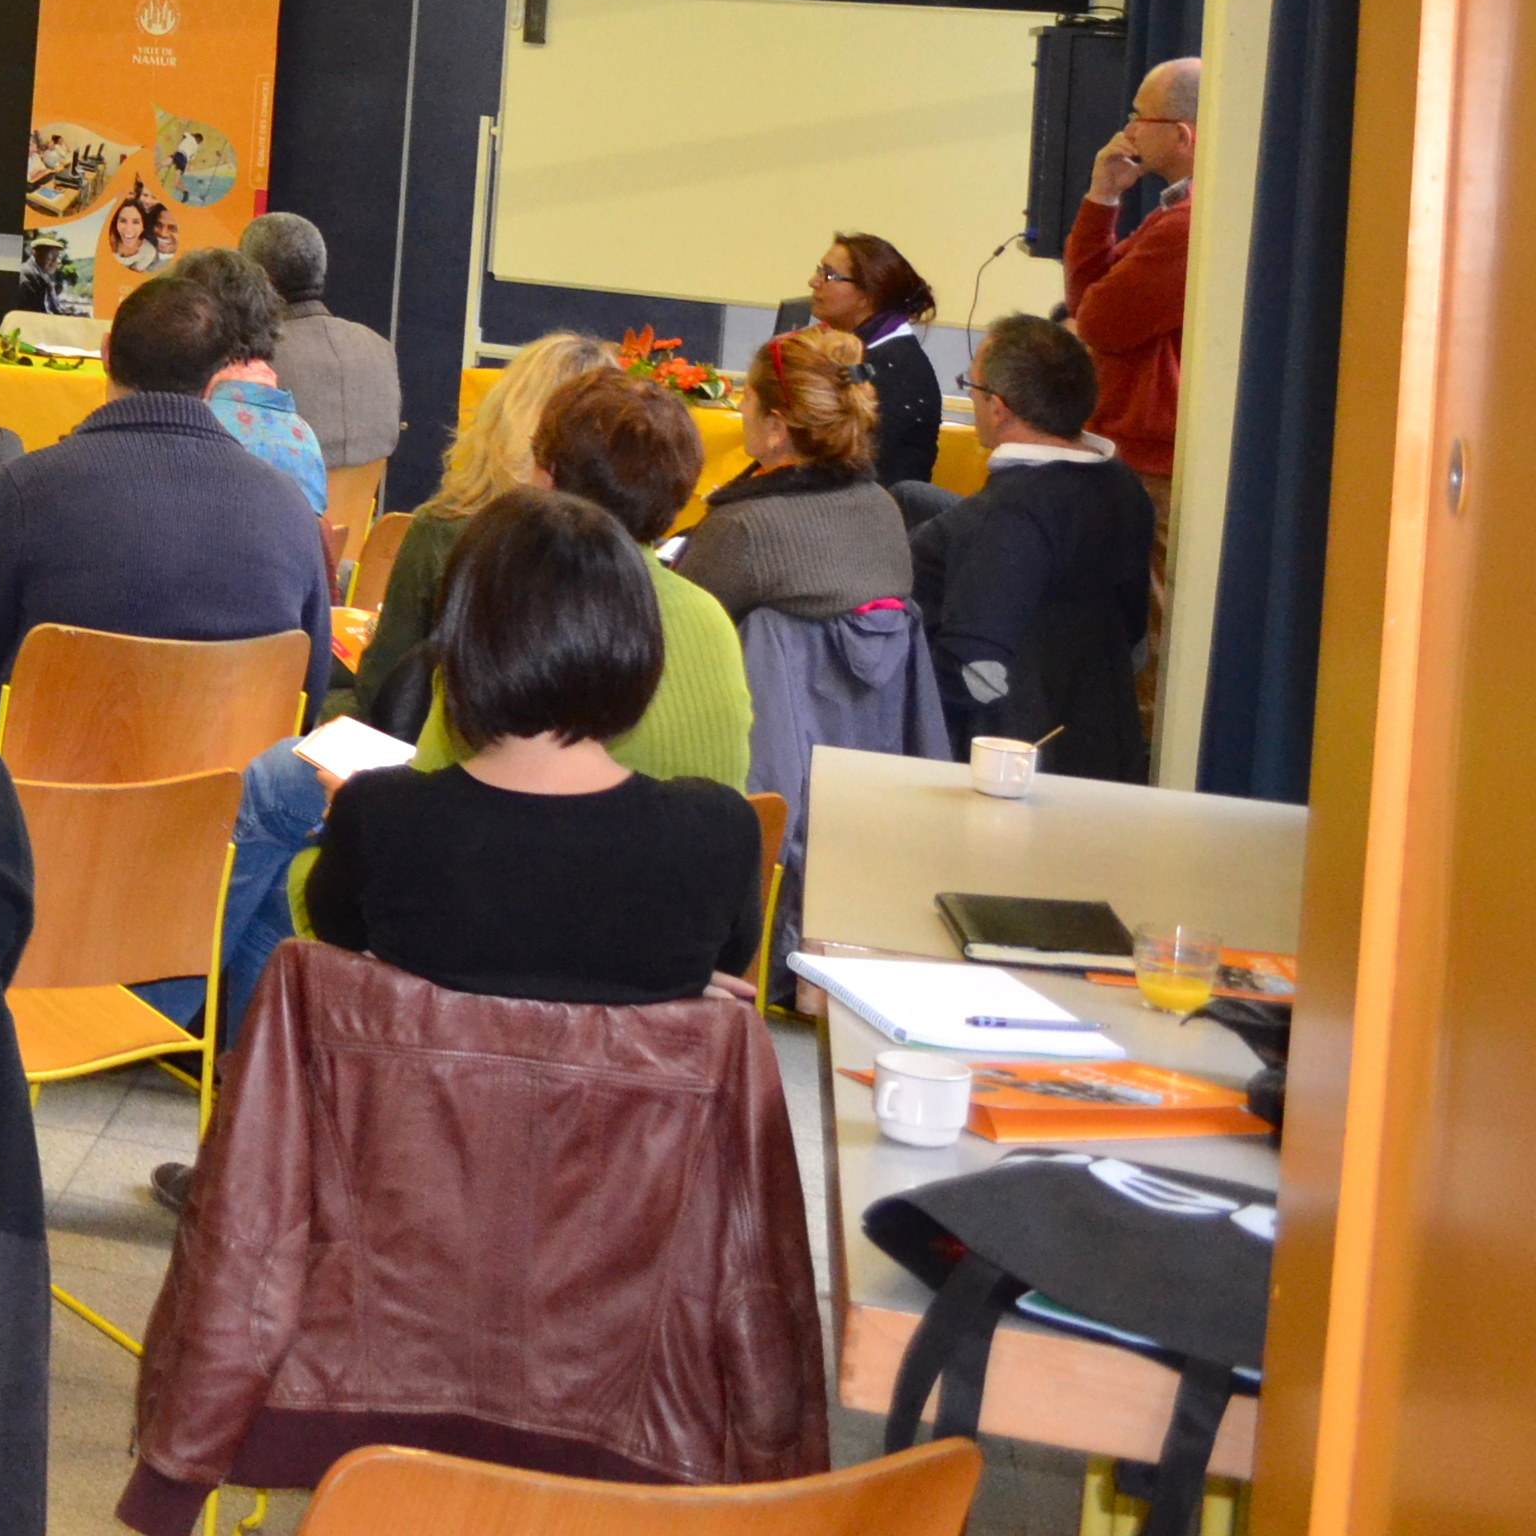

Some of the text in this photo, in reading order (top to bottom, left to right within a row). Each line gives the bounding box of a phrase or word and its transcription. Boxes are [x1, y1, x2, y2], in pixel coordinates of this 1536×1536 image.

[138, 46, 173, 56] VILLE DE
[132, 54, 177, 67] NAMUR
